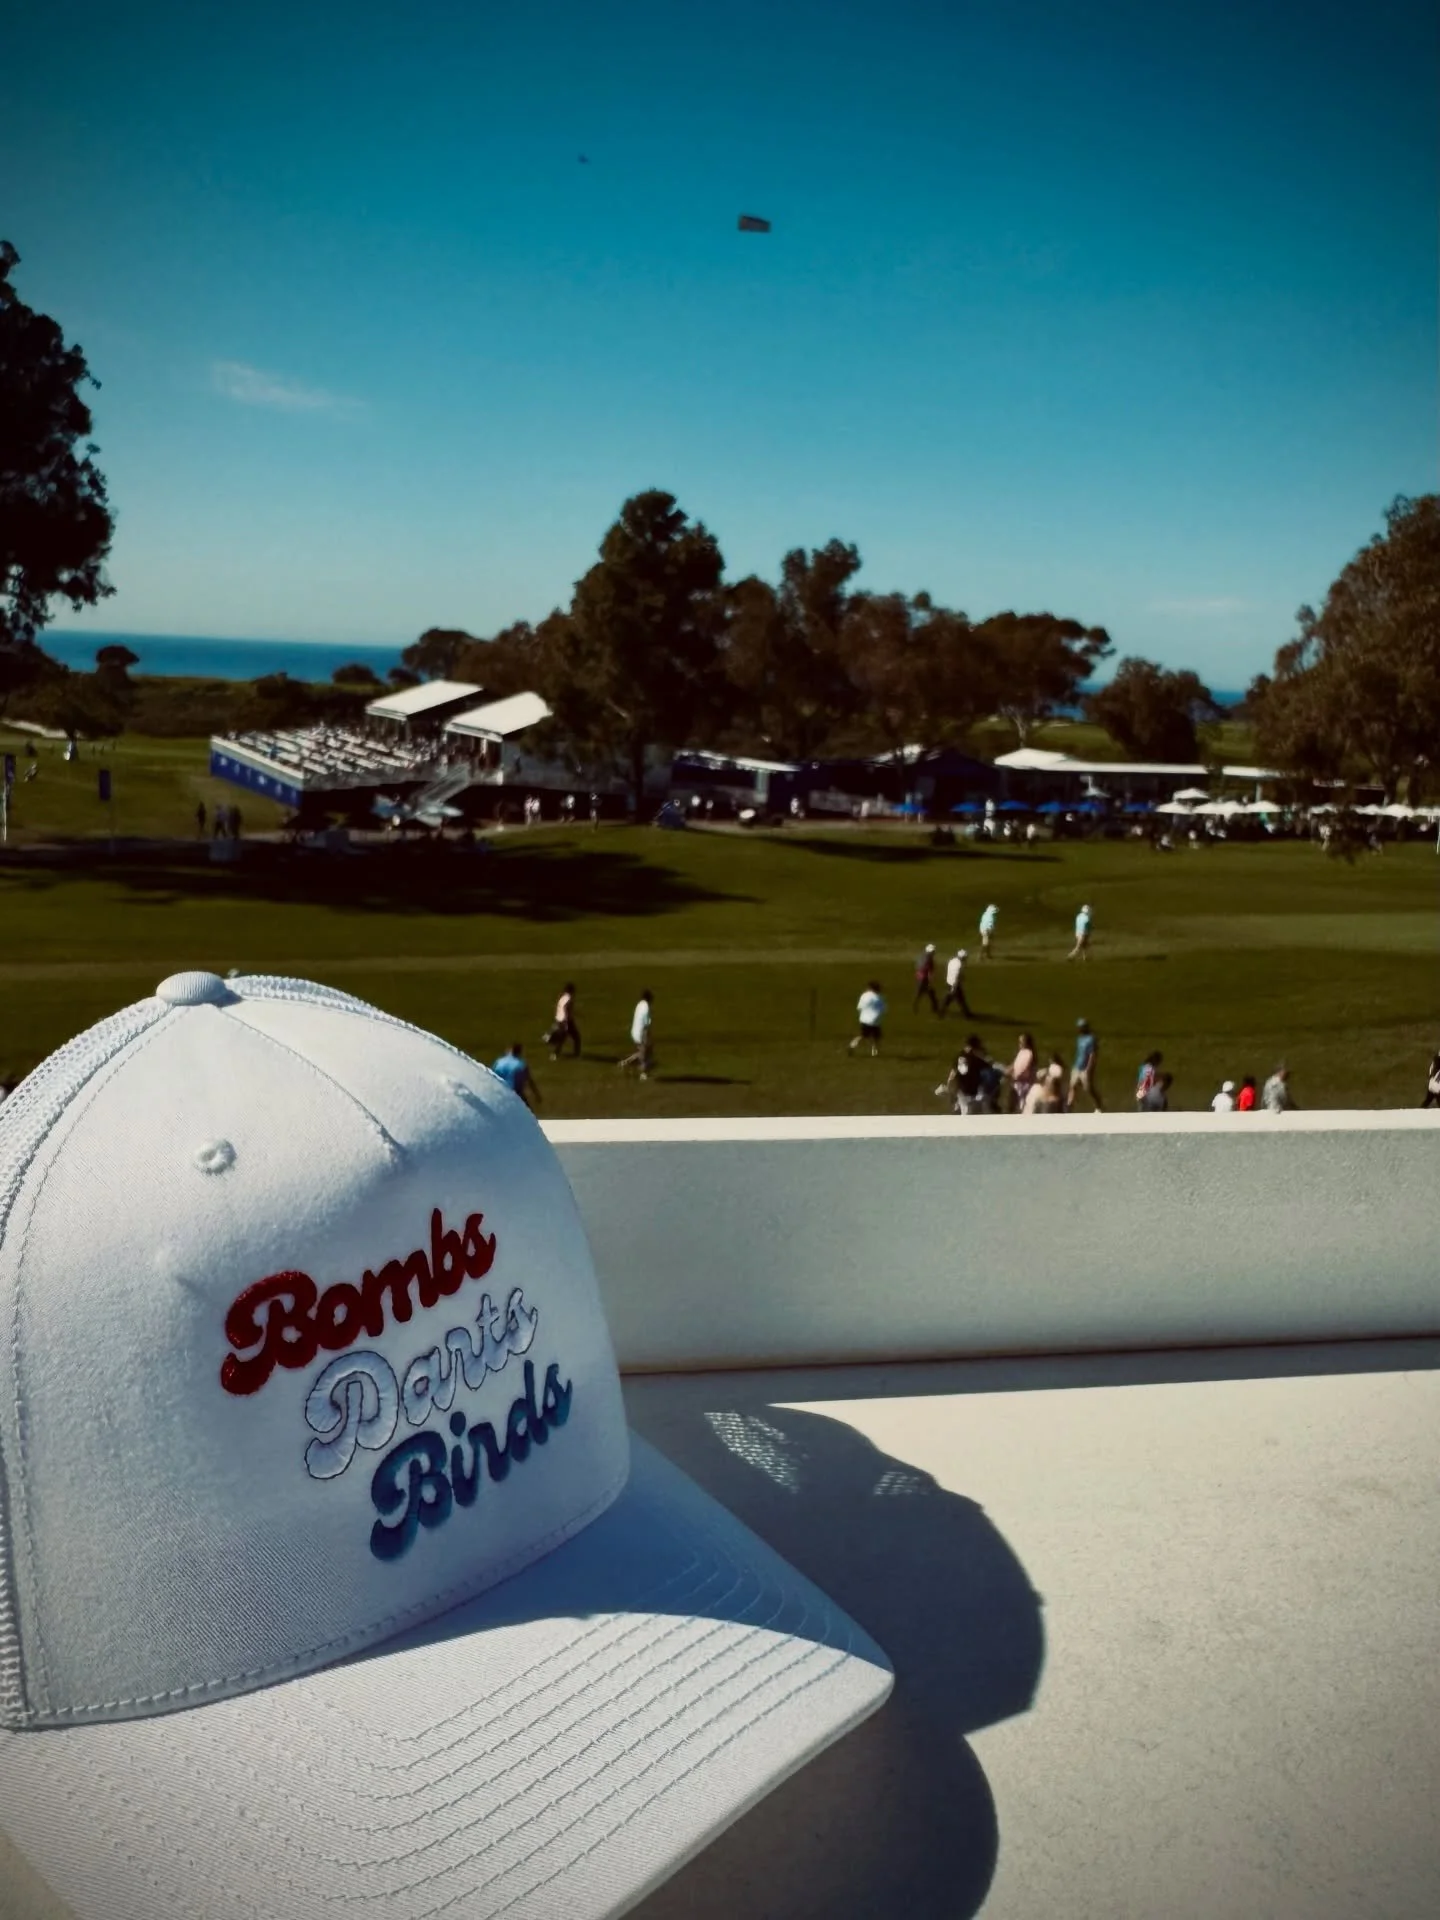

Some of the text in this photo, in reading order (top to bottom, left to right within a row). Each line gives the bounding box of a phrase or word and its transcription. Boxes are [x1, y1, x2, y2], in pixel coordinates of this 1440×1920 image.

[221, 1208, 496, 1395] Bombs
[305, 1288, 538, 1479] Darts
[370, 1360, 572, 1561] Birds
